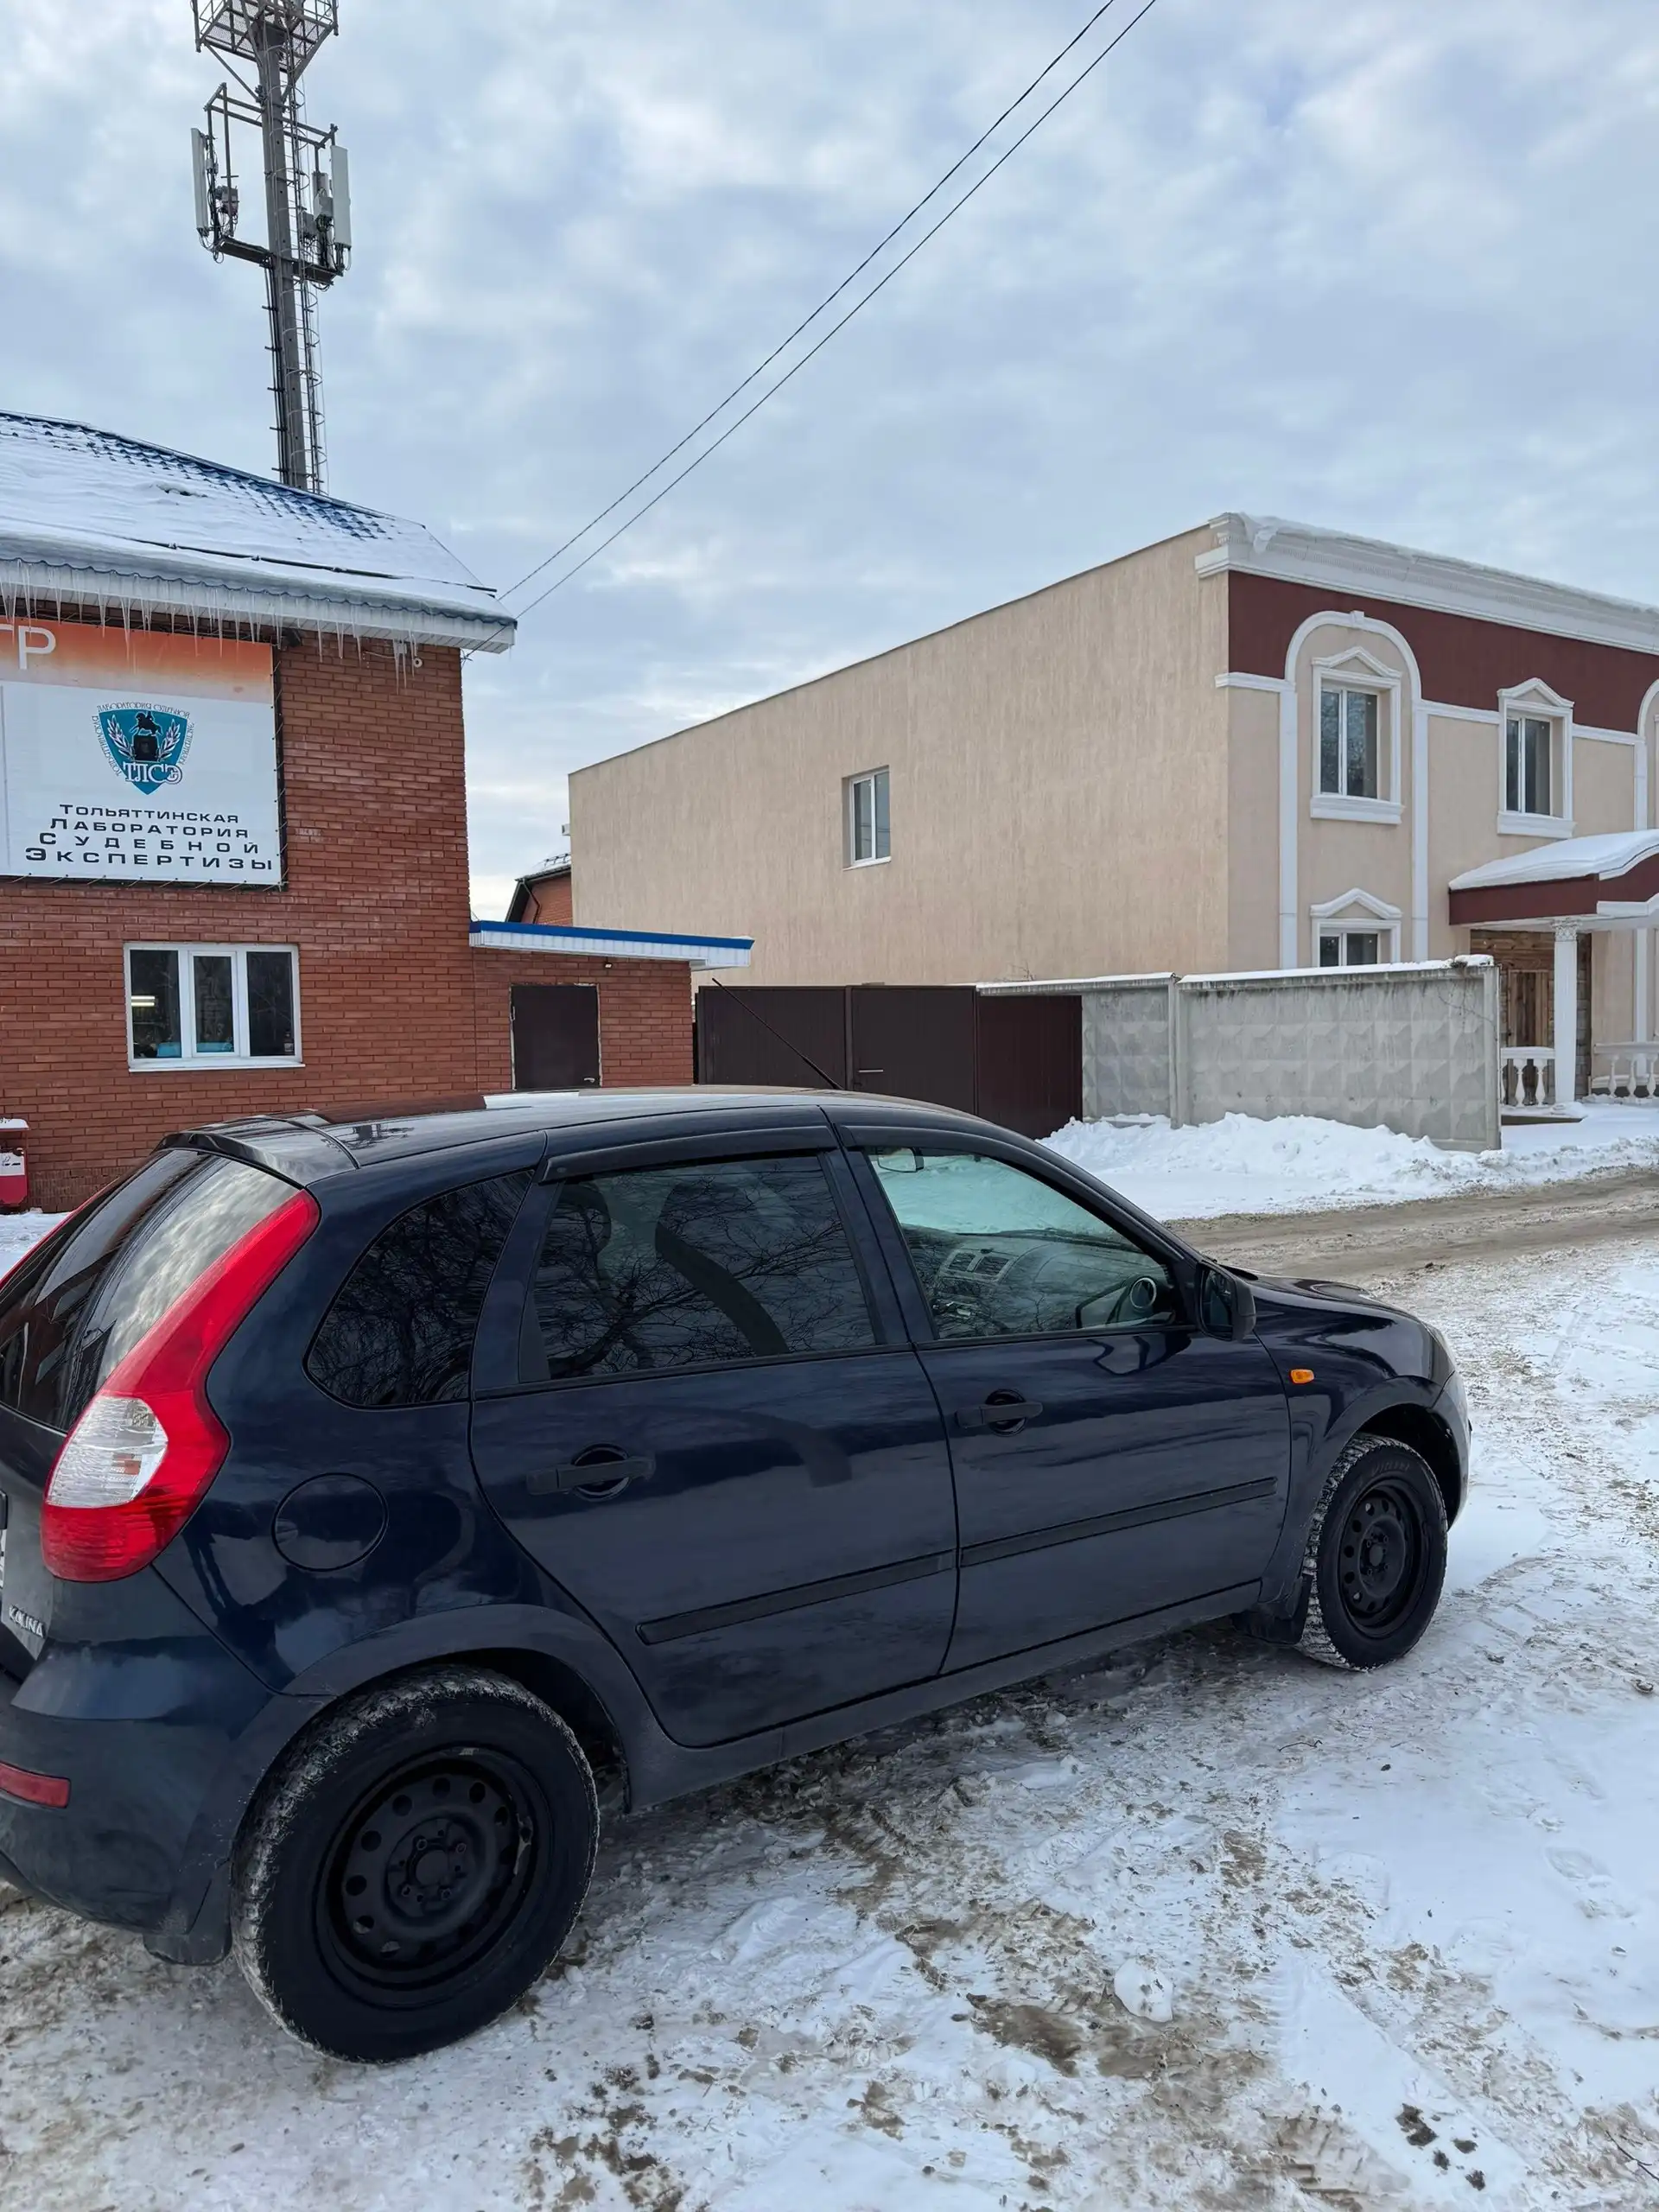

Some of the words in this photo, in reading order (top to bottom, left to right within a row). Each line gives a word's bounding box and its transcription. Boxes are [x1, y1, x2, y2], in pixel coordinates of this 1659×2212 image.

[60, 804, 238, 823] ТОЛЬЯТТИНСКАЯ
[50, 818, 248, 838] ЛАБОРАТОРИЯ
[40, 832, 258, 854] СУДЕБНОЙ
[25, 848, 271, 870] ЭКСПЕРТИЗЫ
